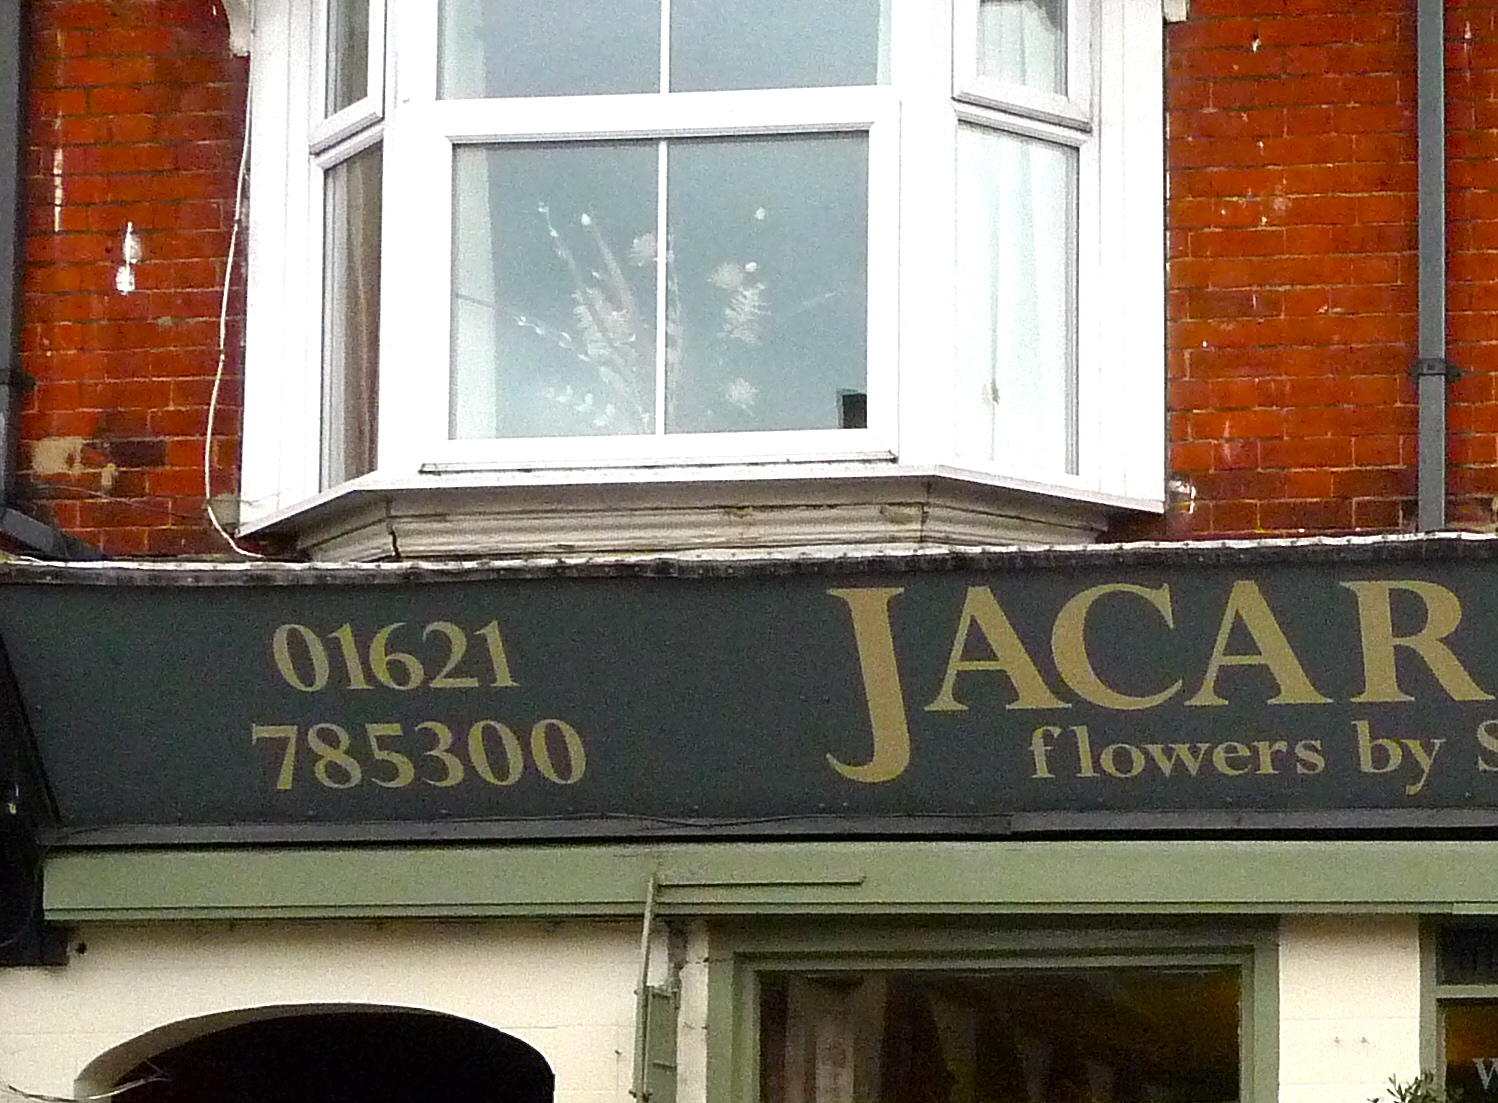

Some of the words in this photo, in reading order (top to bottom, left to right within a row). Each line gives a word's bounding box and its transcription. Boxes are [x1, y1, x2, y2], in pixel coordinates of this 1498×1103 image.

[271, 619, 520, 693] 01621
[251, 718, 588, 791] 785300
[1029, 723, 1325, 779] flowers
[1352, 719, 1446, 796] by
